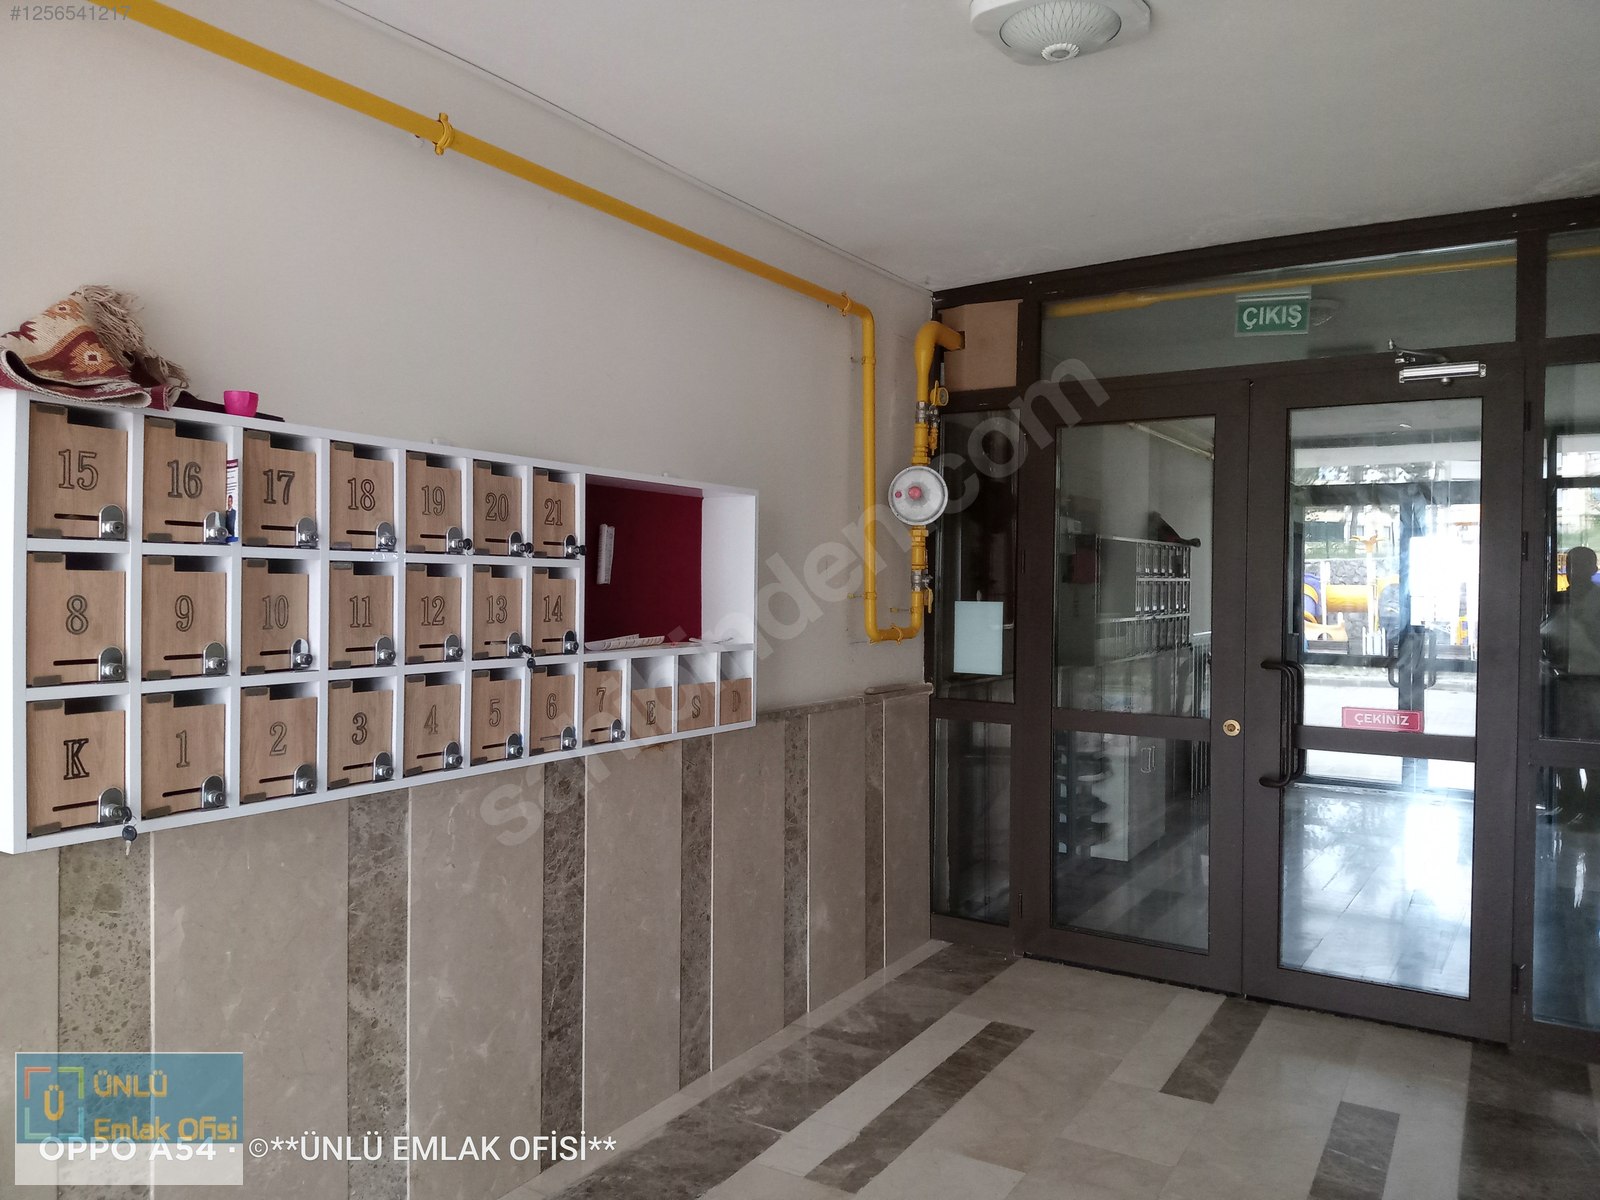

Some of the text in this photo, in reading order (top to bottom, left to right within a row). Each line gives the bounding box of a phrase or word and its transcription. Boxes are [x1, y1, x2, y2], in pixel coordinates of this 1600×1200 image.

[1242, 304, 1303, 330] ÇIKIŞ
[59, 449, 99, 491] 15
[167, 459, 203, 499] 16
[262, 468, 296, 505] 17
[347, 477, 377, 511] 18
[421, 485, 446, 517] 19
[485, 492, 510, 522] 20
[543, 498, 563, 526] 21
[65, 594, 89, 635] 8
[174, 595, 195, 632] 9
[262, 595, 290, 630] 10
[349, 595, 374, 628] 11
[421, 596, 446, 627] 12
[486, 595, 508, 624] 13
[543, 595, 563, 623] 14
[489, 698, 502, 728] 5
[546, 692, 558, 720] 6
[596, 686, 607, 713] 7
[646, 700, 657, 725] E
[691, 695, 702, 719] S
[732, 690, 742, 713] D
[351, 712, 368, 746] 3
[424, 704, 439, 735] 4
[1354, 712, 1410, 726] ÇEKİNİZ
[175, 729, 191, 768] 1
[269, 721, 288, 757] 2
[63, 738, 90, 781] K
